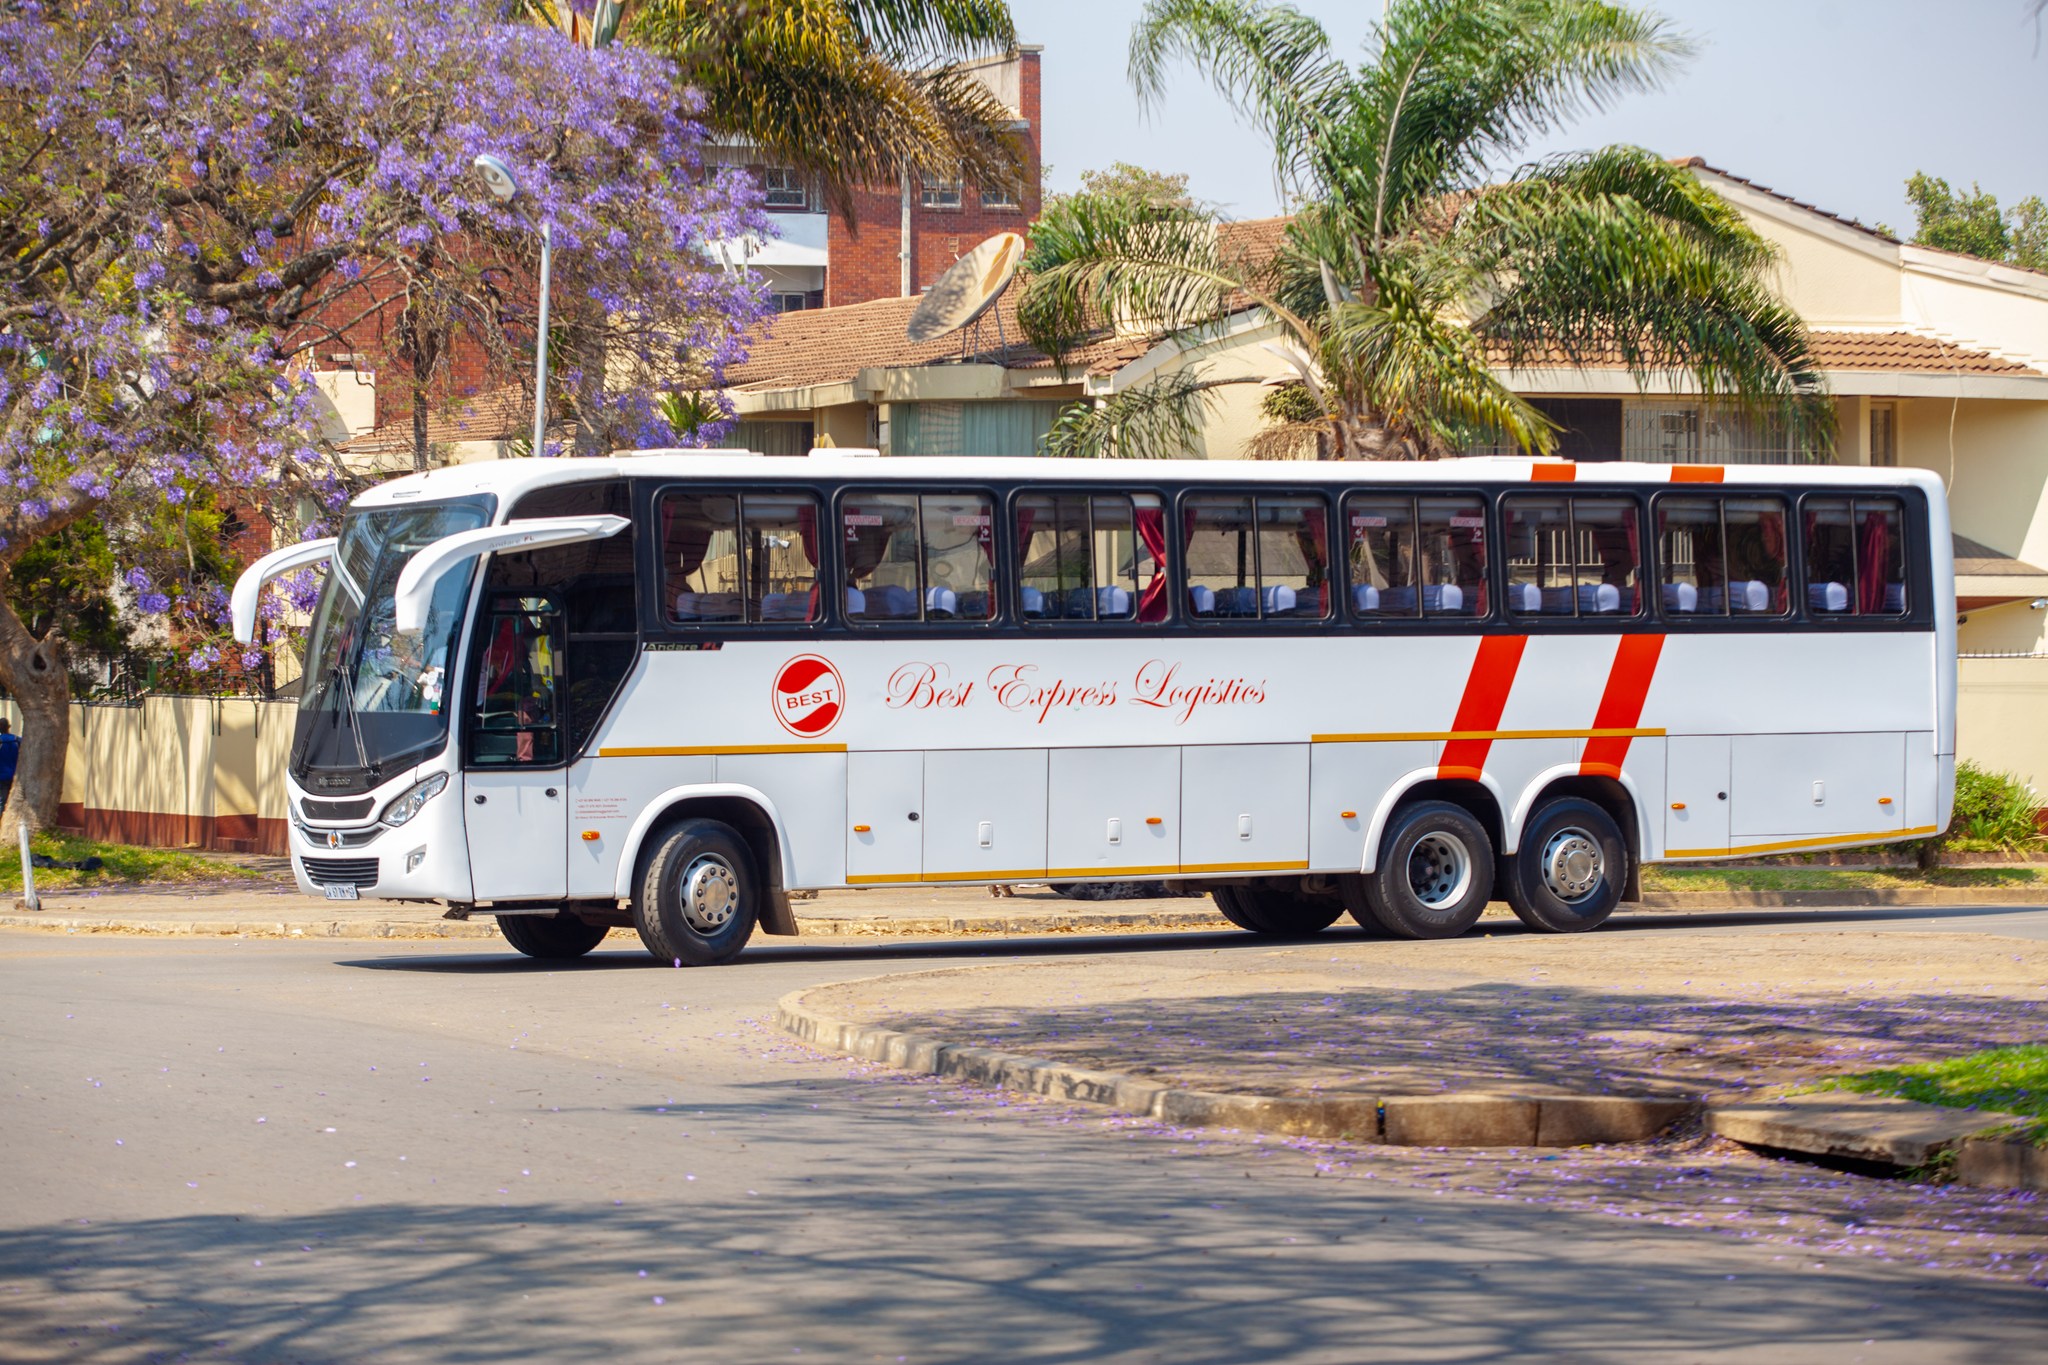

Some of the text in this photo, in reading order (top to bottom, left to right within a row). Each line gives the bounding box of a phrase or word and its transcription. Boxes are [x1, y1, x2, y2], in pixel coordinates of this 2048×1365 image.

[645, 642, 699, 651] Andare
[786, 688, 834, 710] BEST
[885, 658, 1267, 726] Best Express Logistics
